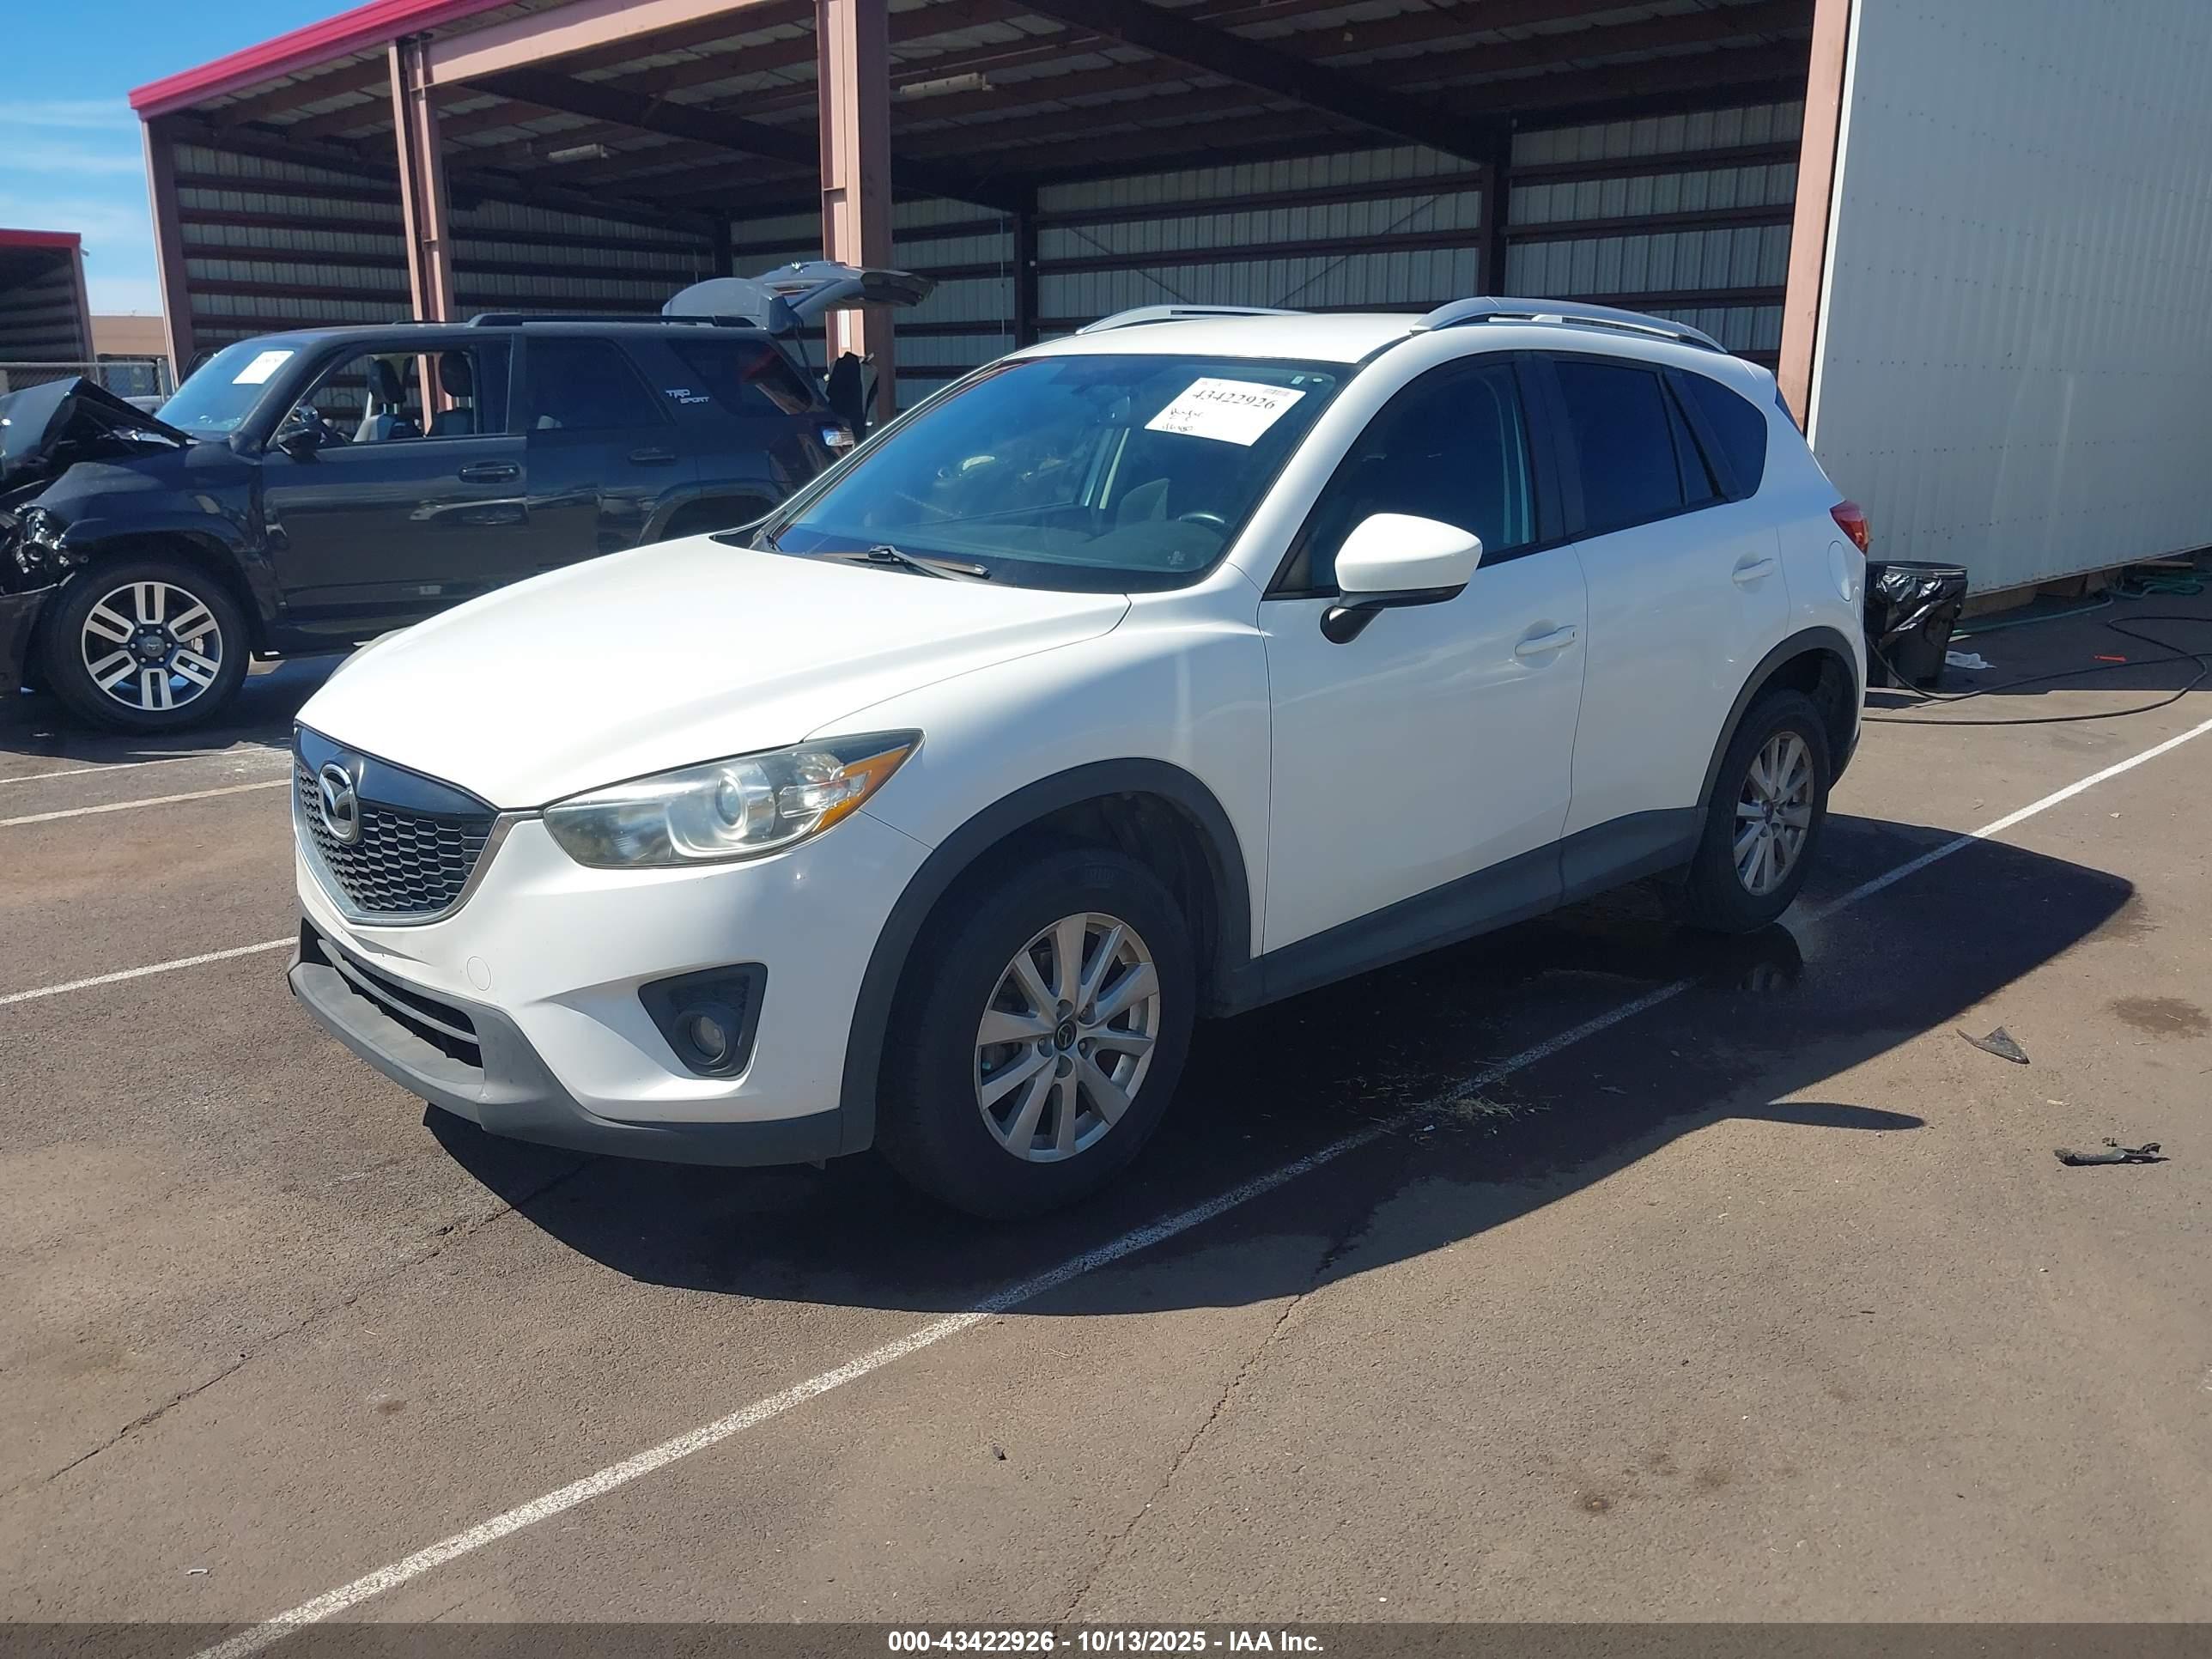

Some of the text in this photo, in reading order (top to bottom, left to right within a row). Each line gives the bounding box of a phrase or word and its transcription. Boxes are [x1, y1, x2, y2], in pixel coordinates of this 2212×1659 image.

[665, 389, 690, 398] TRD
[679, 396, 710, 404] SPORT
[1192, 389, 1278, 410] 43422926
